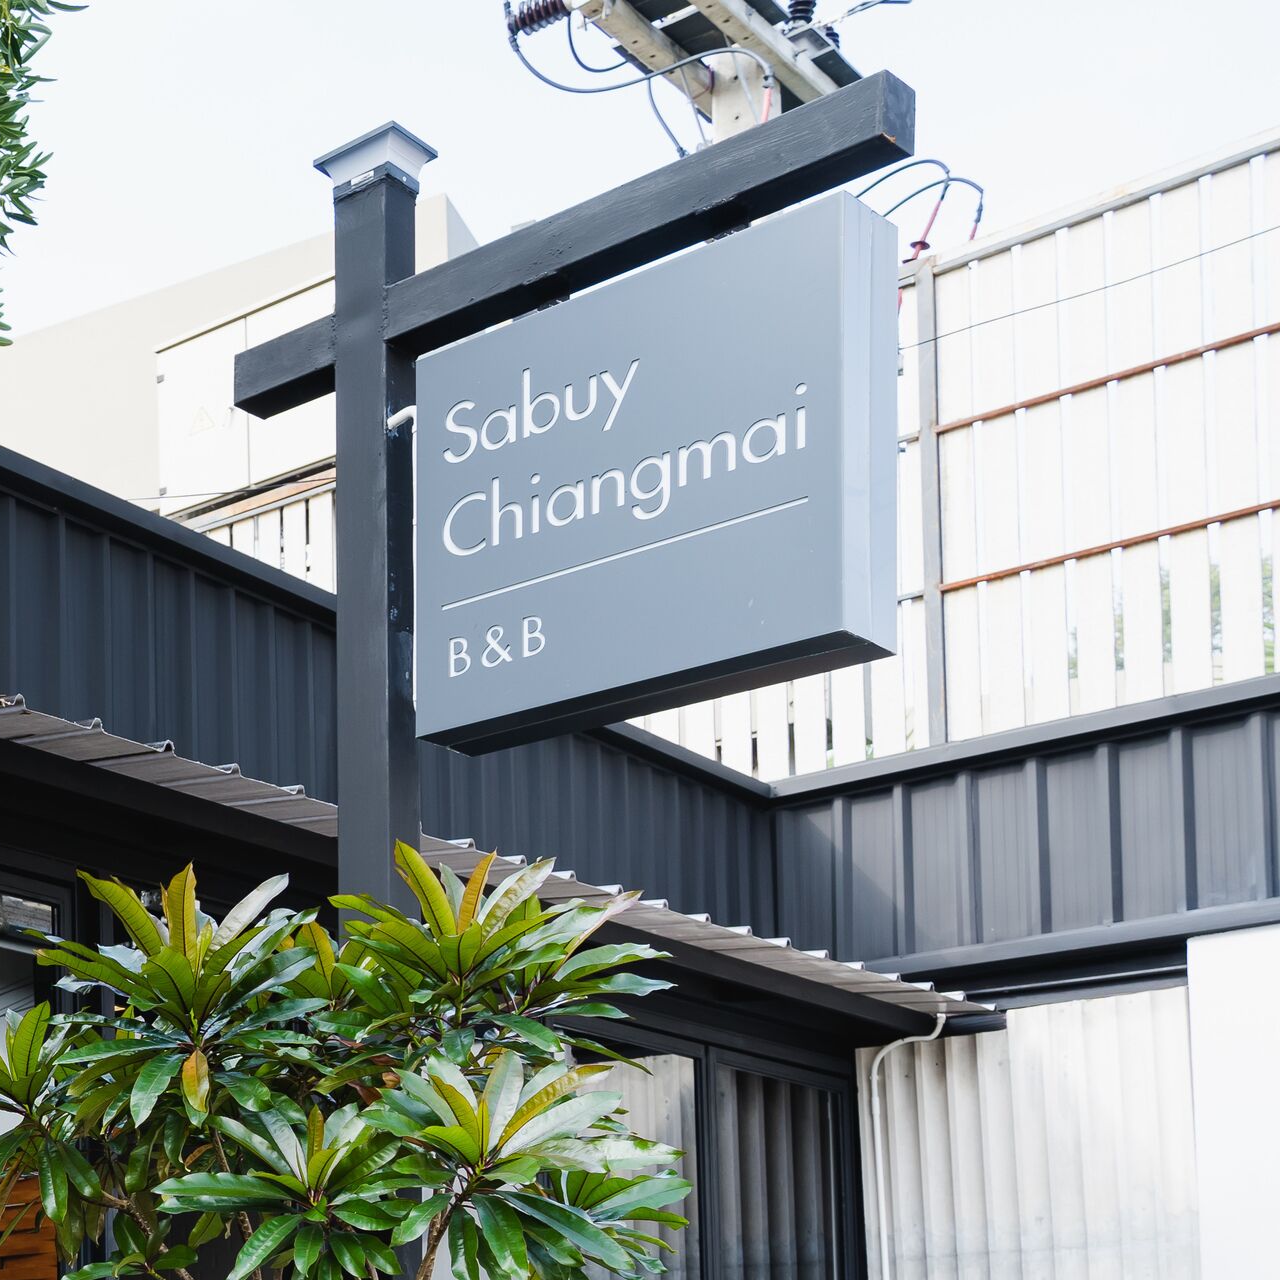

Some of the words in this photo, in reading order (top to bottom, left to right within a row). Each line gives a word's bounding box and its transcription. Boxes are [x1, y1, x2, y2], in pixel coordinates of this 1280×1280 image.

[442, 358, 640, 464] Sabuy
[442, 383, 808, 557] Chiangmai
[448, 615, 547, 679] B&B
